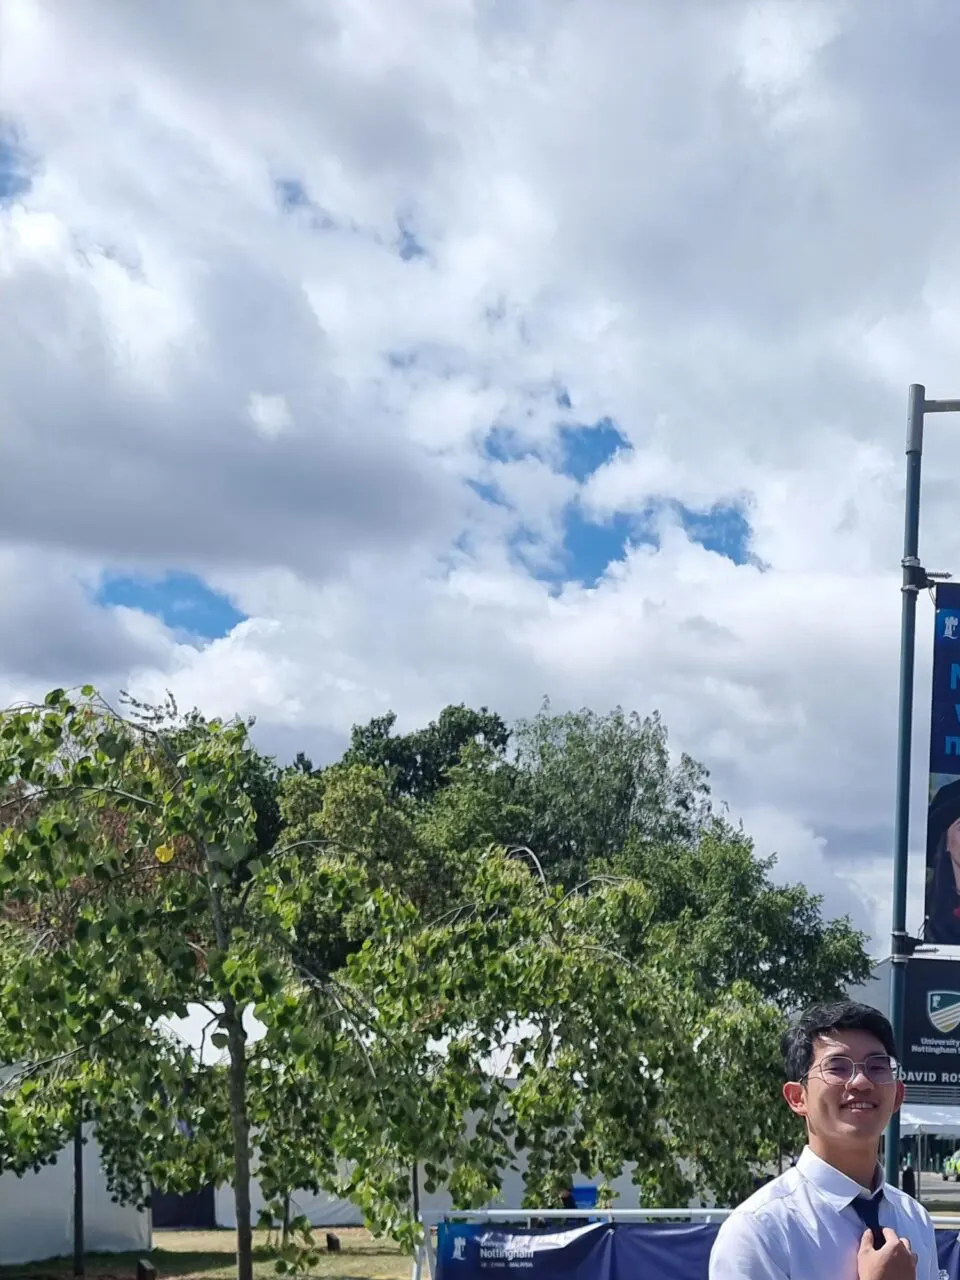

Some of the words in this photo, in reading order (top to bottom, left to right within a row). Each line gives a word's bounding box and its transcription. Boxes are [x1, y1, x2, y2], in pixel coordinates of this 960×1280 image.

[921, 1037, 960, 1048] University
[911, 1045, 957, 1055] Nottingham
[899, 1071, 937, 1082] DAVID
[480, 1248, 534, 1261] Nottingham
